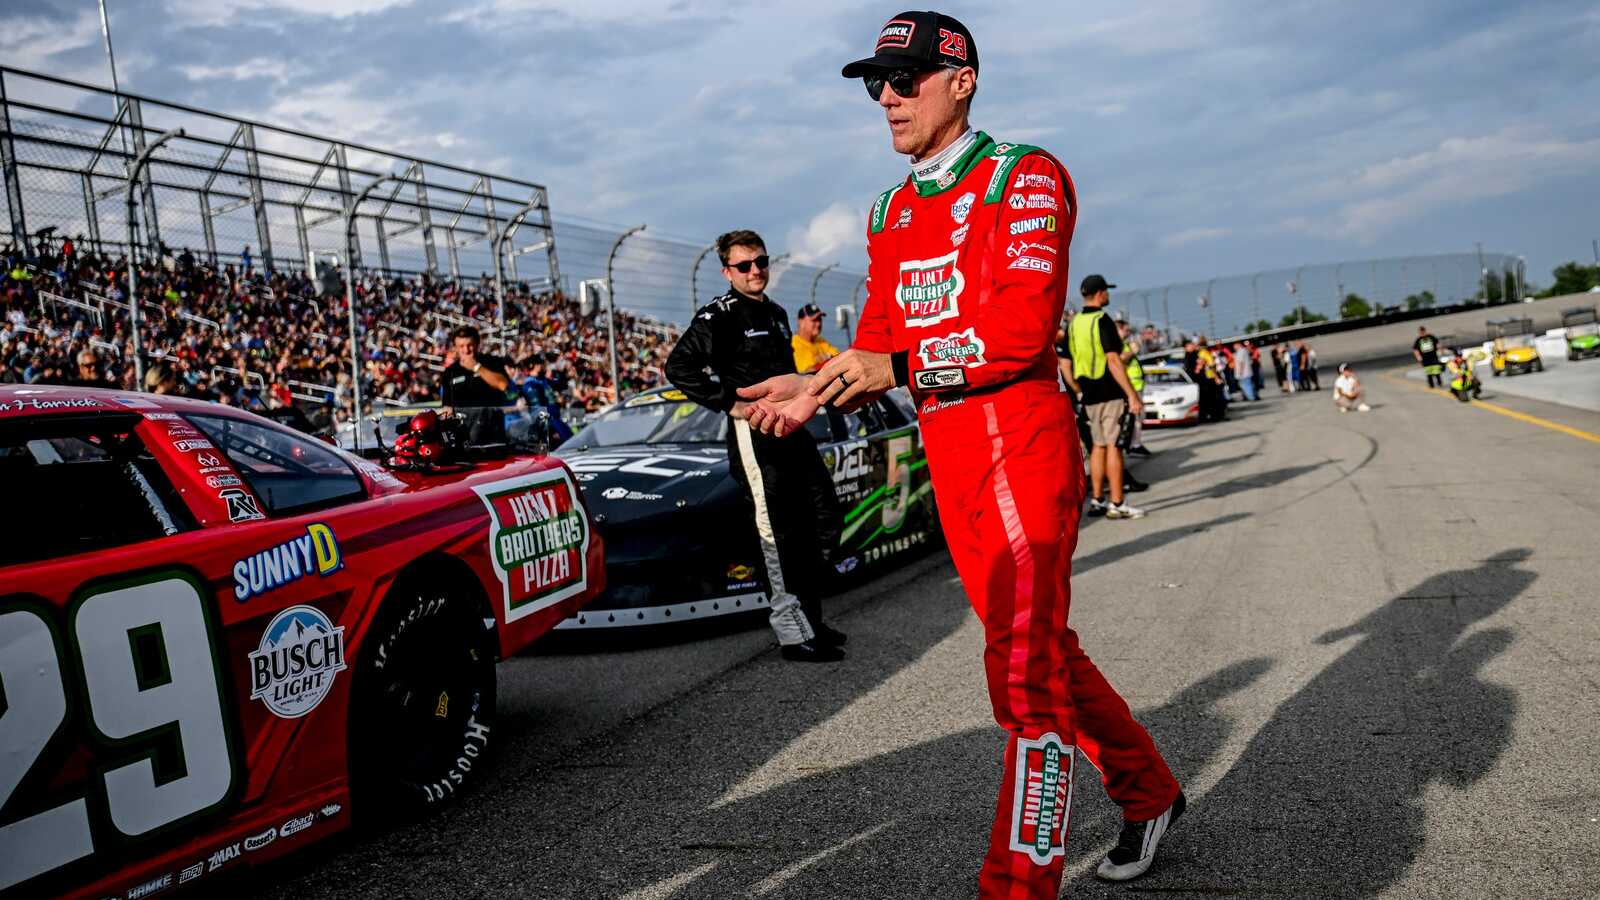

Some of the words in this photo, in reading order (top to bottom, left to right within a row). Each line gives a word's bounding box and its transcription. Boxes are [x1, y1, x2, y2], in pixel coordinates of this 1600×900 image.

[939, 28, 967, 61] 29
[1009, 214, 1056, 236] SUNNYD
[922, 373, 936, 384] sfi
[881, 433, 911, 530] 5
[508, 488, 559, 528] HUNT
[233, 522, 340, 601] SUNNYD
[499, 515, 583, 566] BROTHERS
[522, 549, 571, 594] PIZZA
[253, 633, 342, 692] BUSCH
[273, 672, 324, 702] LIGHT
[0, 577, 232, 891] 29
[1023, 767, 1044, 826] HUNT
[1037, 747, 1060, 850] BROTHERS
